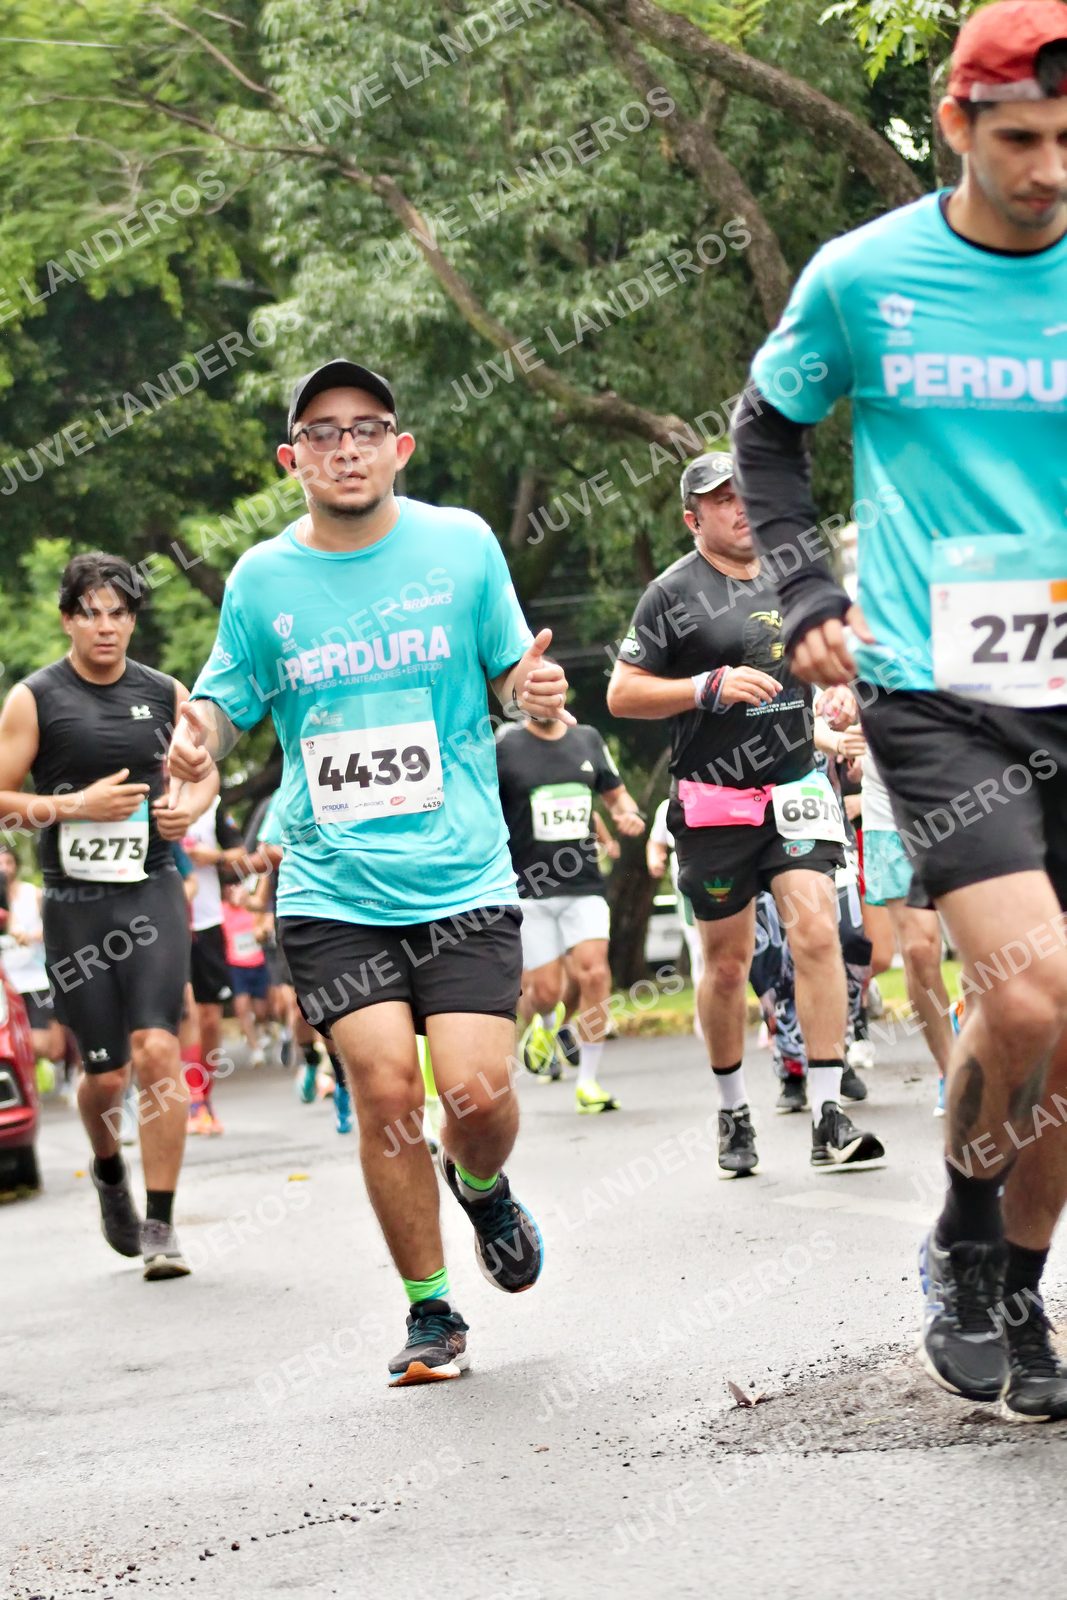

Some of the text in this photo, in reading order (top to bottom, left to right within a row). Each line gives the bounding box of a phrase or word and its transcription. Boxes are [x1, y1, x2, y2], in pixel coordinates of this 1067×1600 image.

[402, 593, 452, 611] BROOKS
[285, 625, 451, 691] PERDURA
[343, 668, 401, 686] JUNTEADORES
[318, 745, 431, 792] 4439
[423, 800, 442, 809] 4439
[541, 807, 587, 826] 1542
[69, 837, 144, 862] 4273
